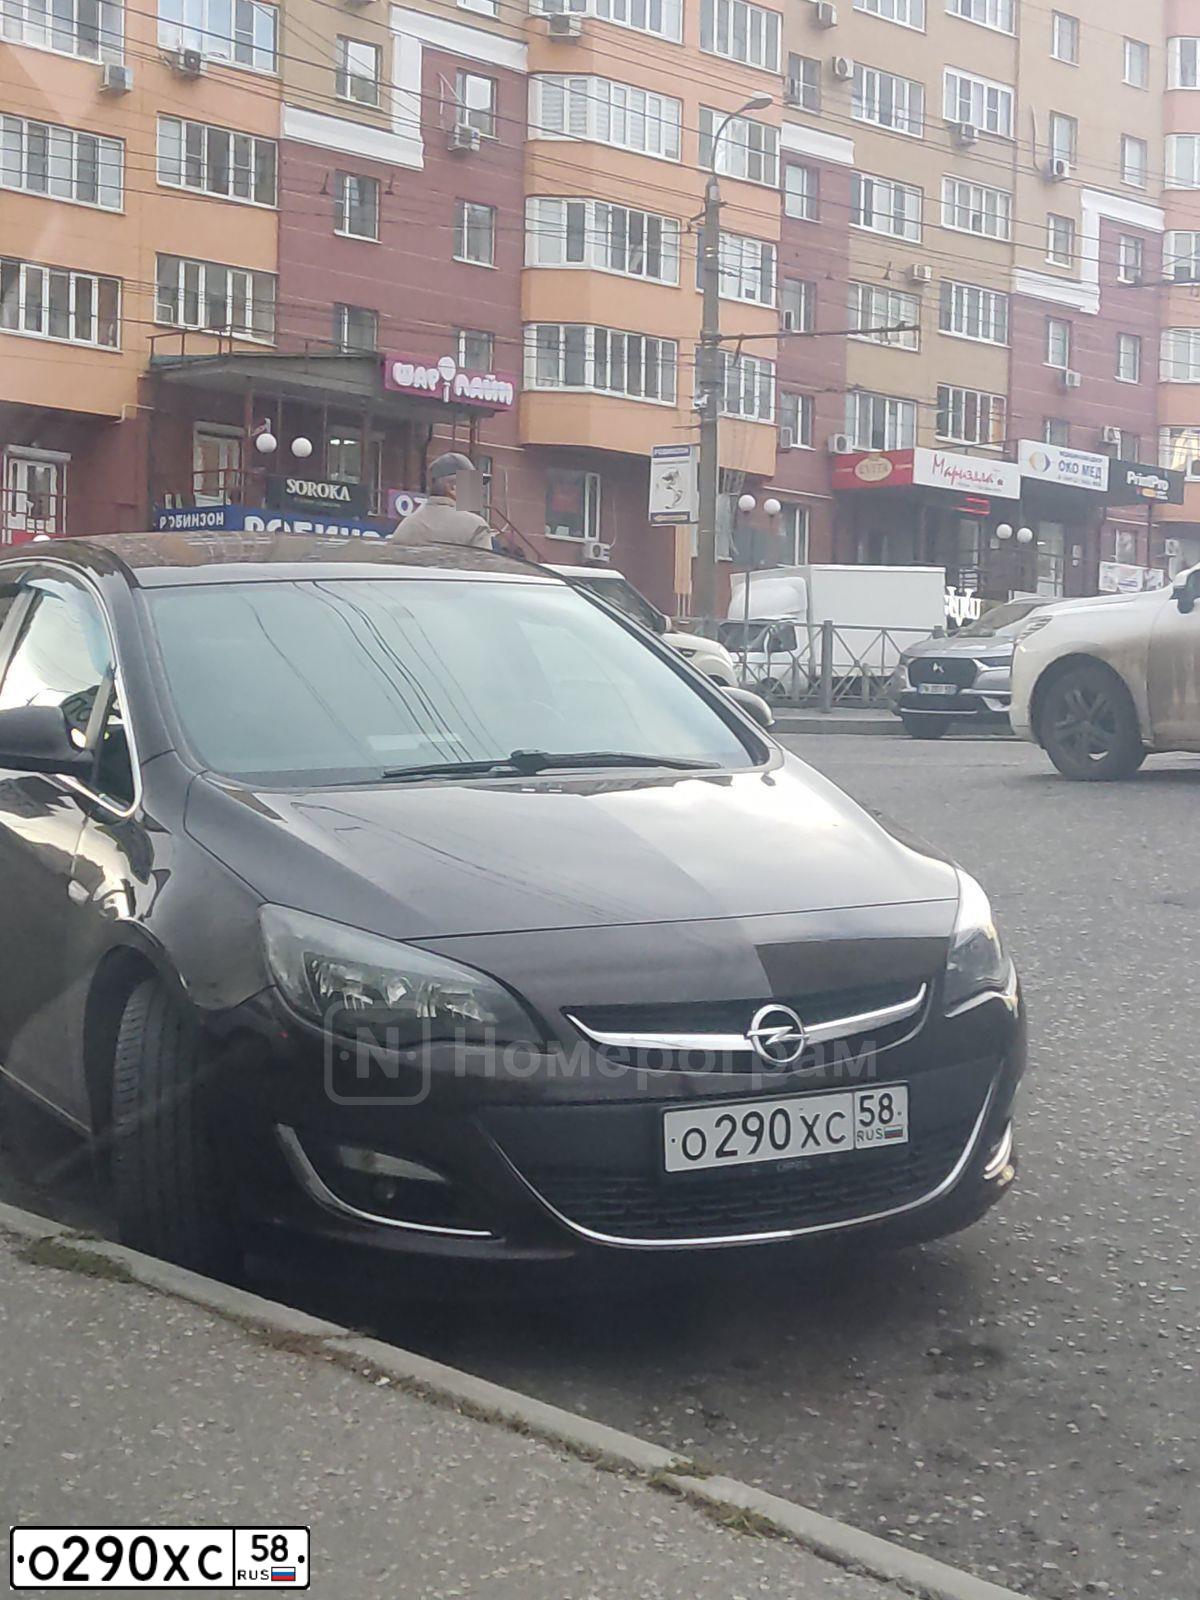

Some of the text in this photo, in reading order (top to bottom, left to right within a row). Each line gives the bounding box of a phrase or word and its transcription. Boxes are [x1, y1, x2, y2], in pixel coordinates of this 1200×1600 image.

[393, 362, 440, 391] ШАР
[286, 478, 351, 501] SOROKA
[858, 1092, 895, 1127] 58
[856, 1129, 884, 1143] RUS
